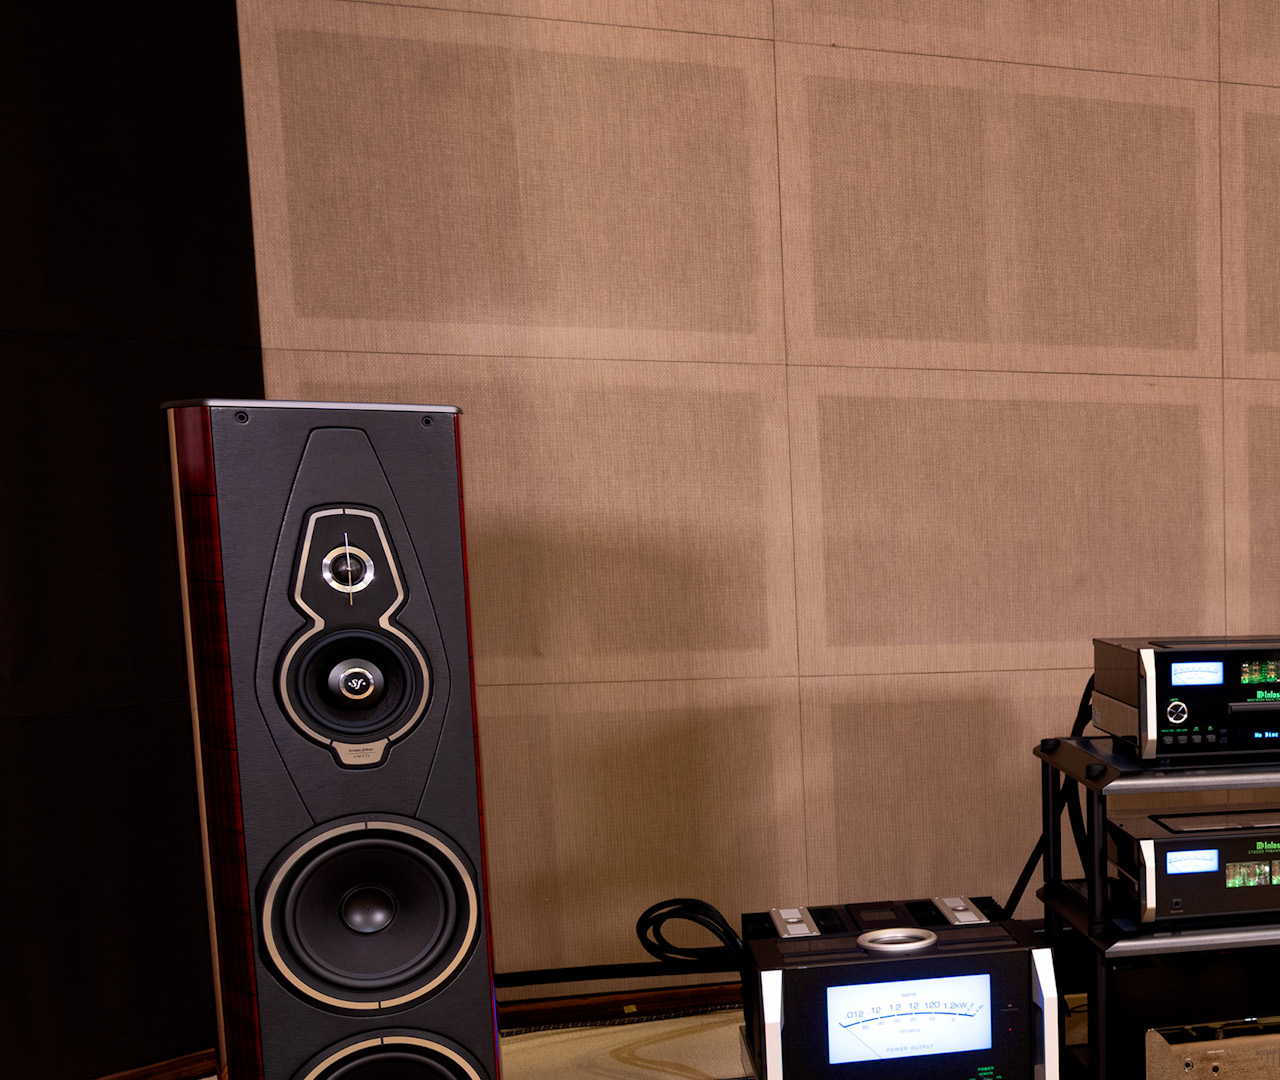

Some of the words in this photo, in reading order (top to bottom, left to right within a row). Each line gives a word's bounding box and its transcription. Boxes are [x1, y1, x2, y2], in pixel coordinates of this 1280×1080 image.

[889, 1003, 902, 1012] 1.2
[908, 1002, 919, 1010] 12
[924, 1000, 941, 1009] 120
[910, 1043, 934, 1051] OUTPUT
